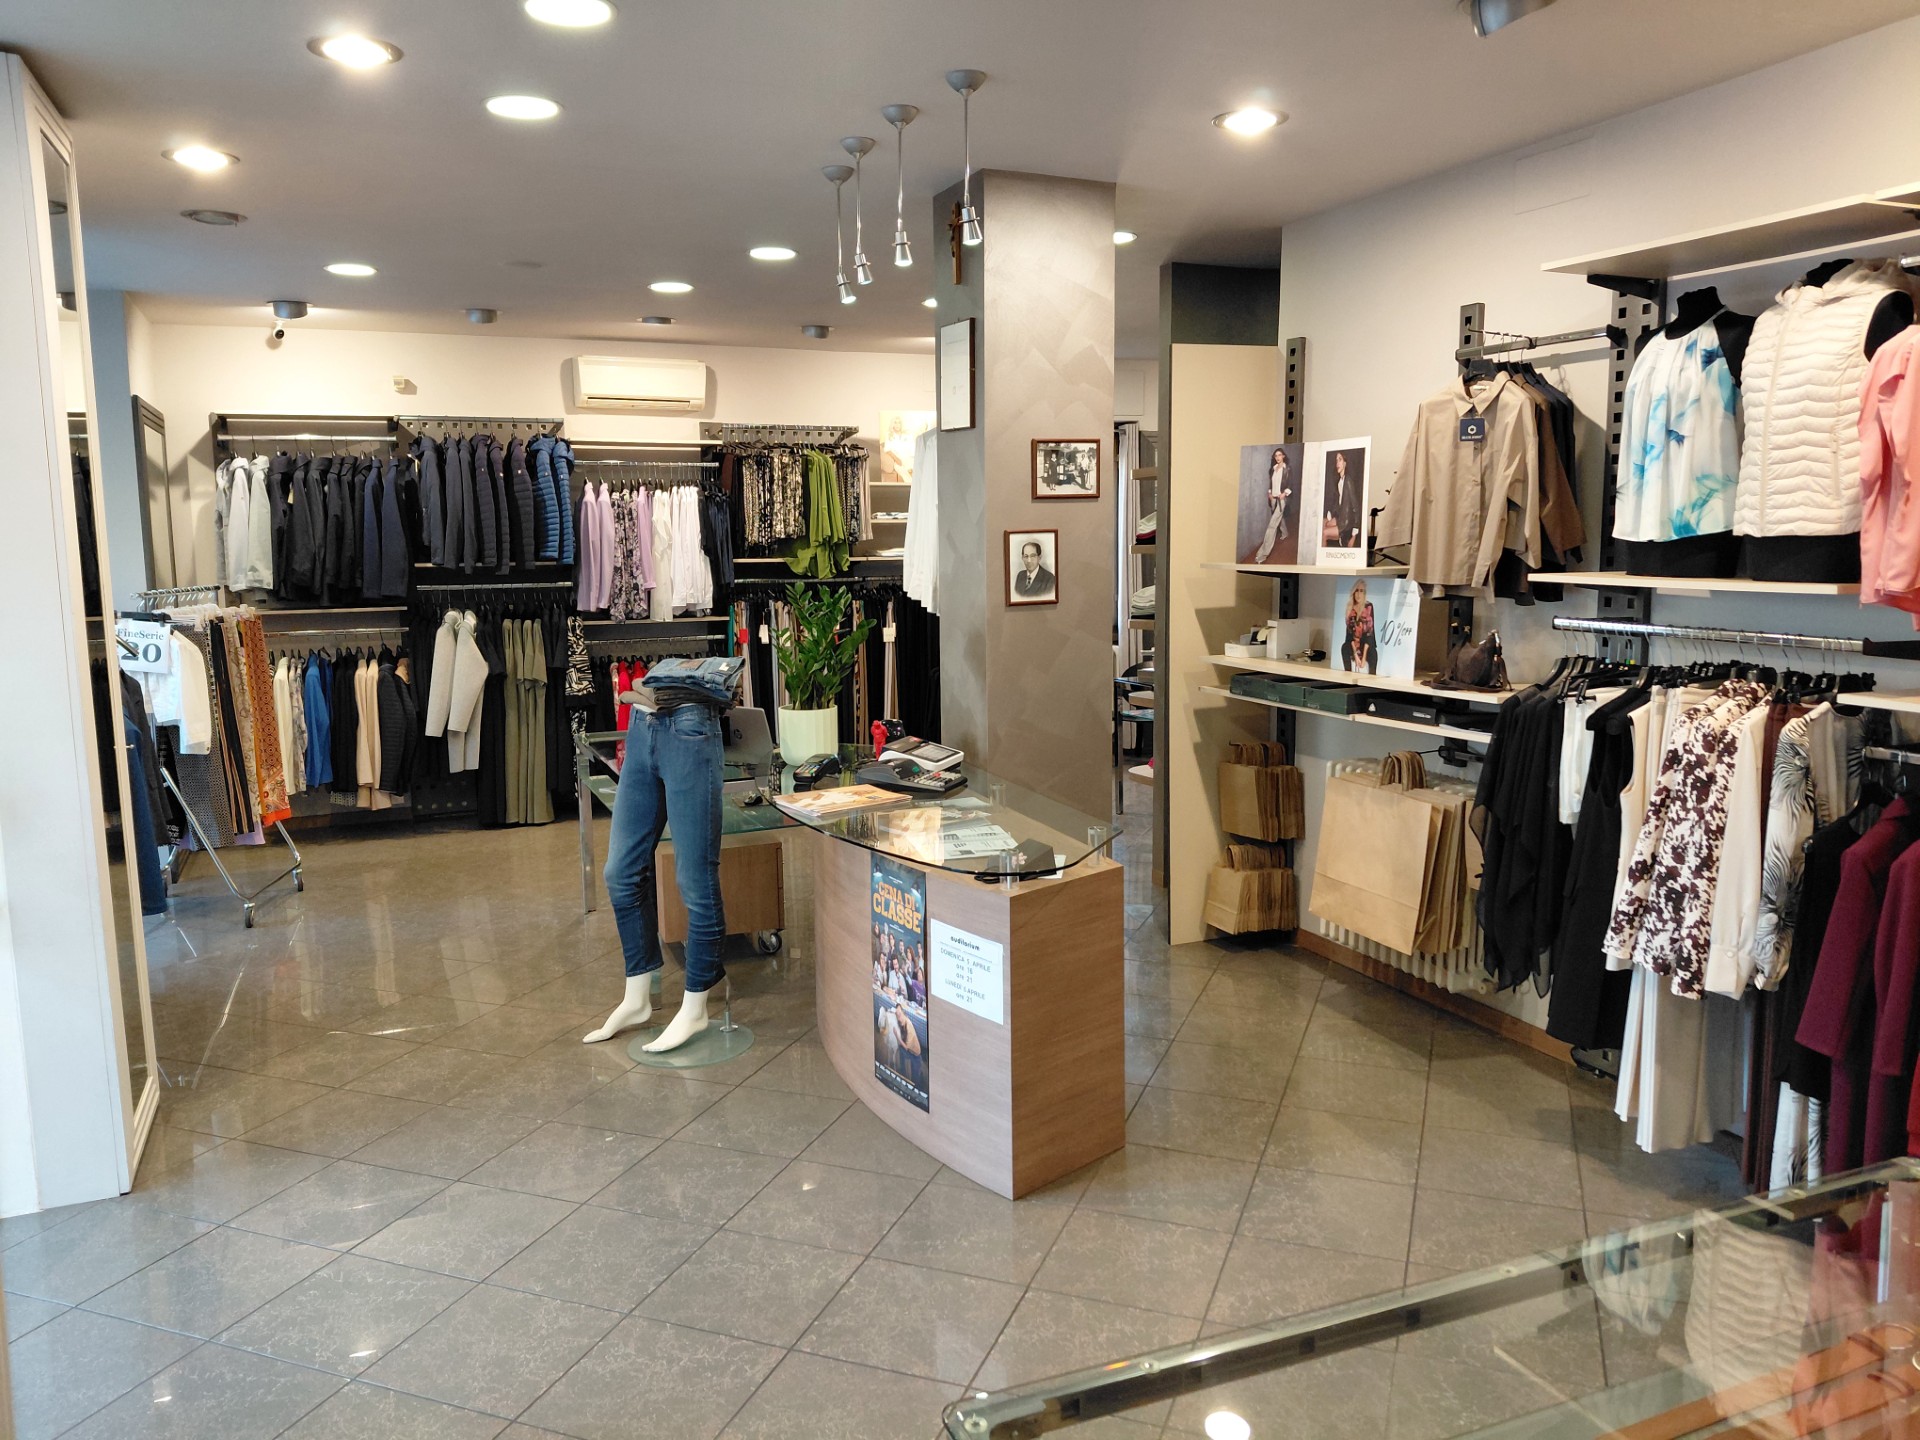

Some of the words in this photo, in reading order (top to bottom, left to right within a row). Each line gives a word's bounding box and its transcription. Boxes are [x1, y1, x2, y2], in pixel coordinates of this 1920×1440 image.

[117, 628, 164, 640] FineSerie
[878, 881, 904, 906] CENA
[904, 892, 916, 911] DI
[873, 892, 922, 934] CLASSE
[950, 935, 980, 951] auditorium
[940, 947, 965, 962] DOMENICA
[972, 960, 991, 973] APRILE
[967, 988, 985, 1000] APRILE
